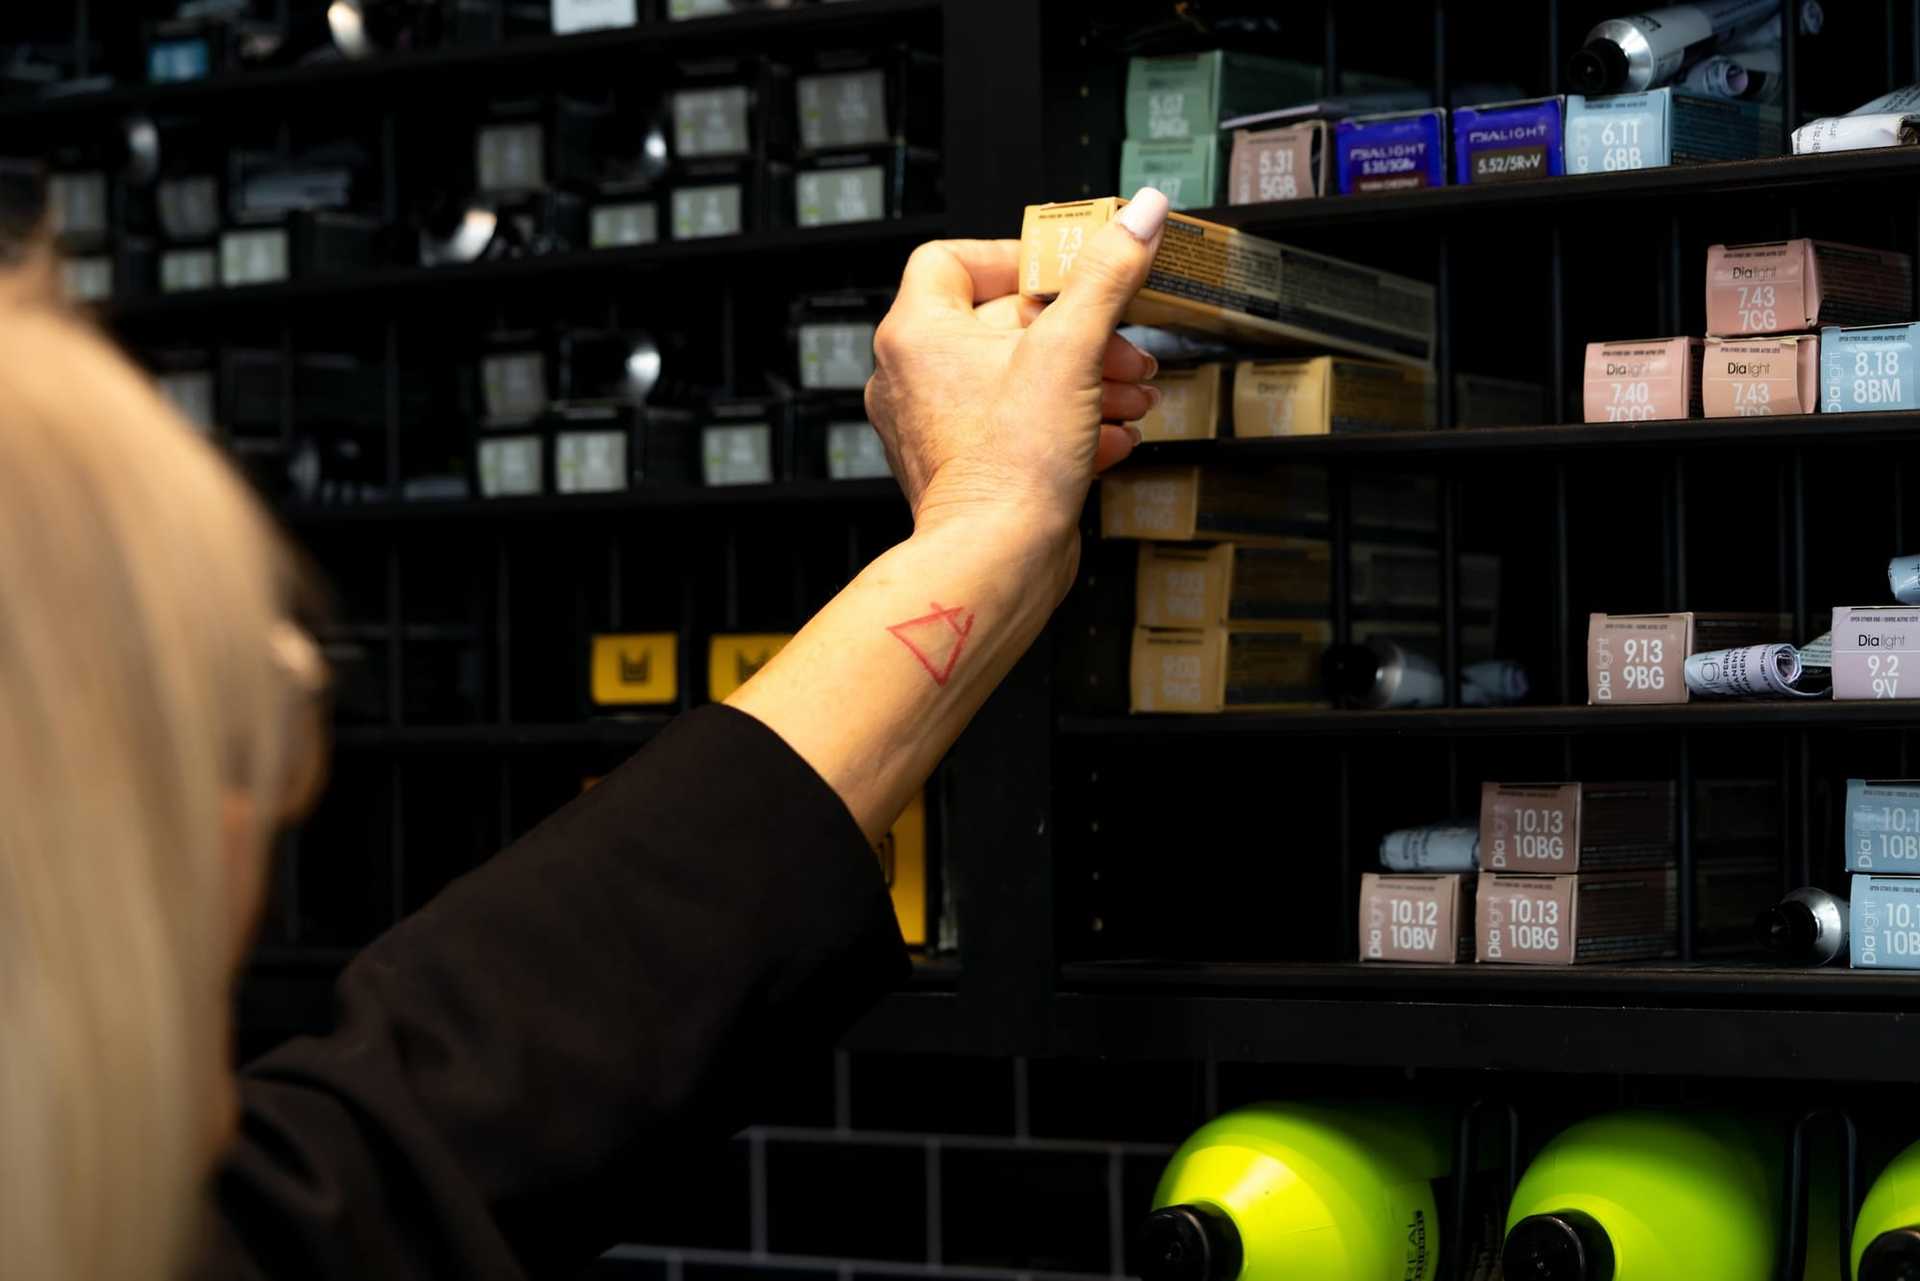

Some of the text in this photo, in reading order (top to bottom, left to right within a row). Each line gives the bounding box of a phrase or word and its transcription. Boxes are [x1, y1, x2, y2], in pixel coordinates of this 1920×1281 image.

[1604, 147, 1641, 171] 6BB
[1738, 286, 1775, 308] 7.43
[1739, 309, 1777, 331] 7CG
[1607, 363, 1653, 377] Dialigh
[1727, 362, 1771, 377] Dialight
[1855, 351, 1899, 376] 8.18
[1610, 383, 1649, 402] 7.40
[1733, 383, 1769, 403] 7.43
[1854, 378, 1901, 404] 8BM
[1624, 639, 1663, 663] 9.13
[1858, 634, 1905, 649] Dialight
[1597, 638, 1613, 700] Dialight
[1624, 666, 1664, 690] 9BG
[1867, 655, 1899, 677] 9.2
[1872, 678, 1898, 699] 9V
[1514, 809, 1563, 833] 10.13
[1514, 836, 1564, 860] 10BG
[1880, 835, 1920, 860] 10B
[1390, 900, 1437, 926] 10.12
[1509, 899, 1558, 924] 10.13
[1390, 926, 1437, 951] 10BV
[1508, 925, 1559, 950] 10BG
[1862, 899, 1879, 964] Dialight
